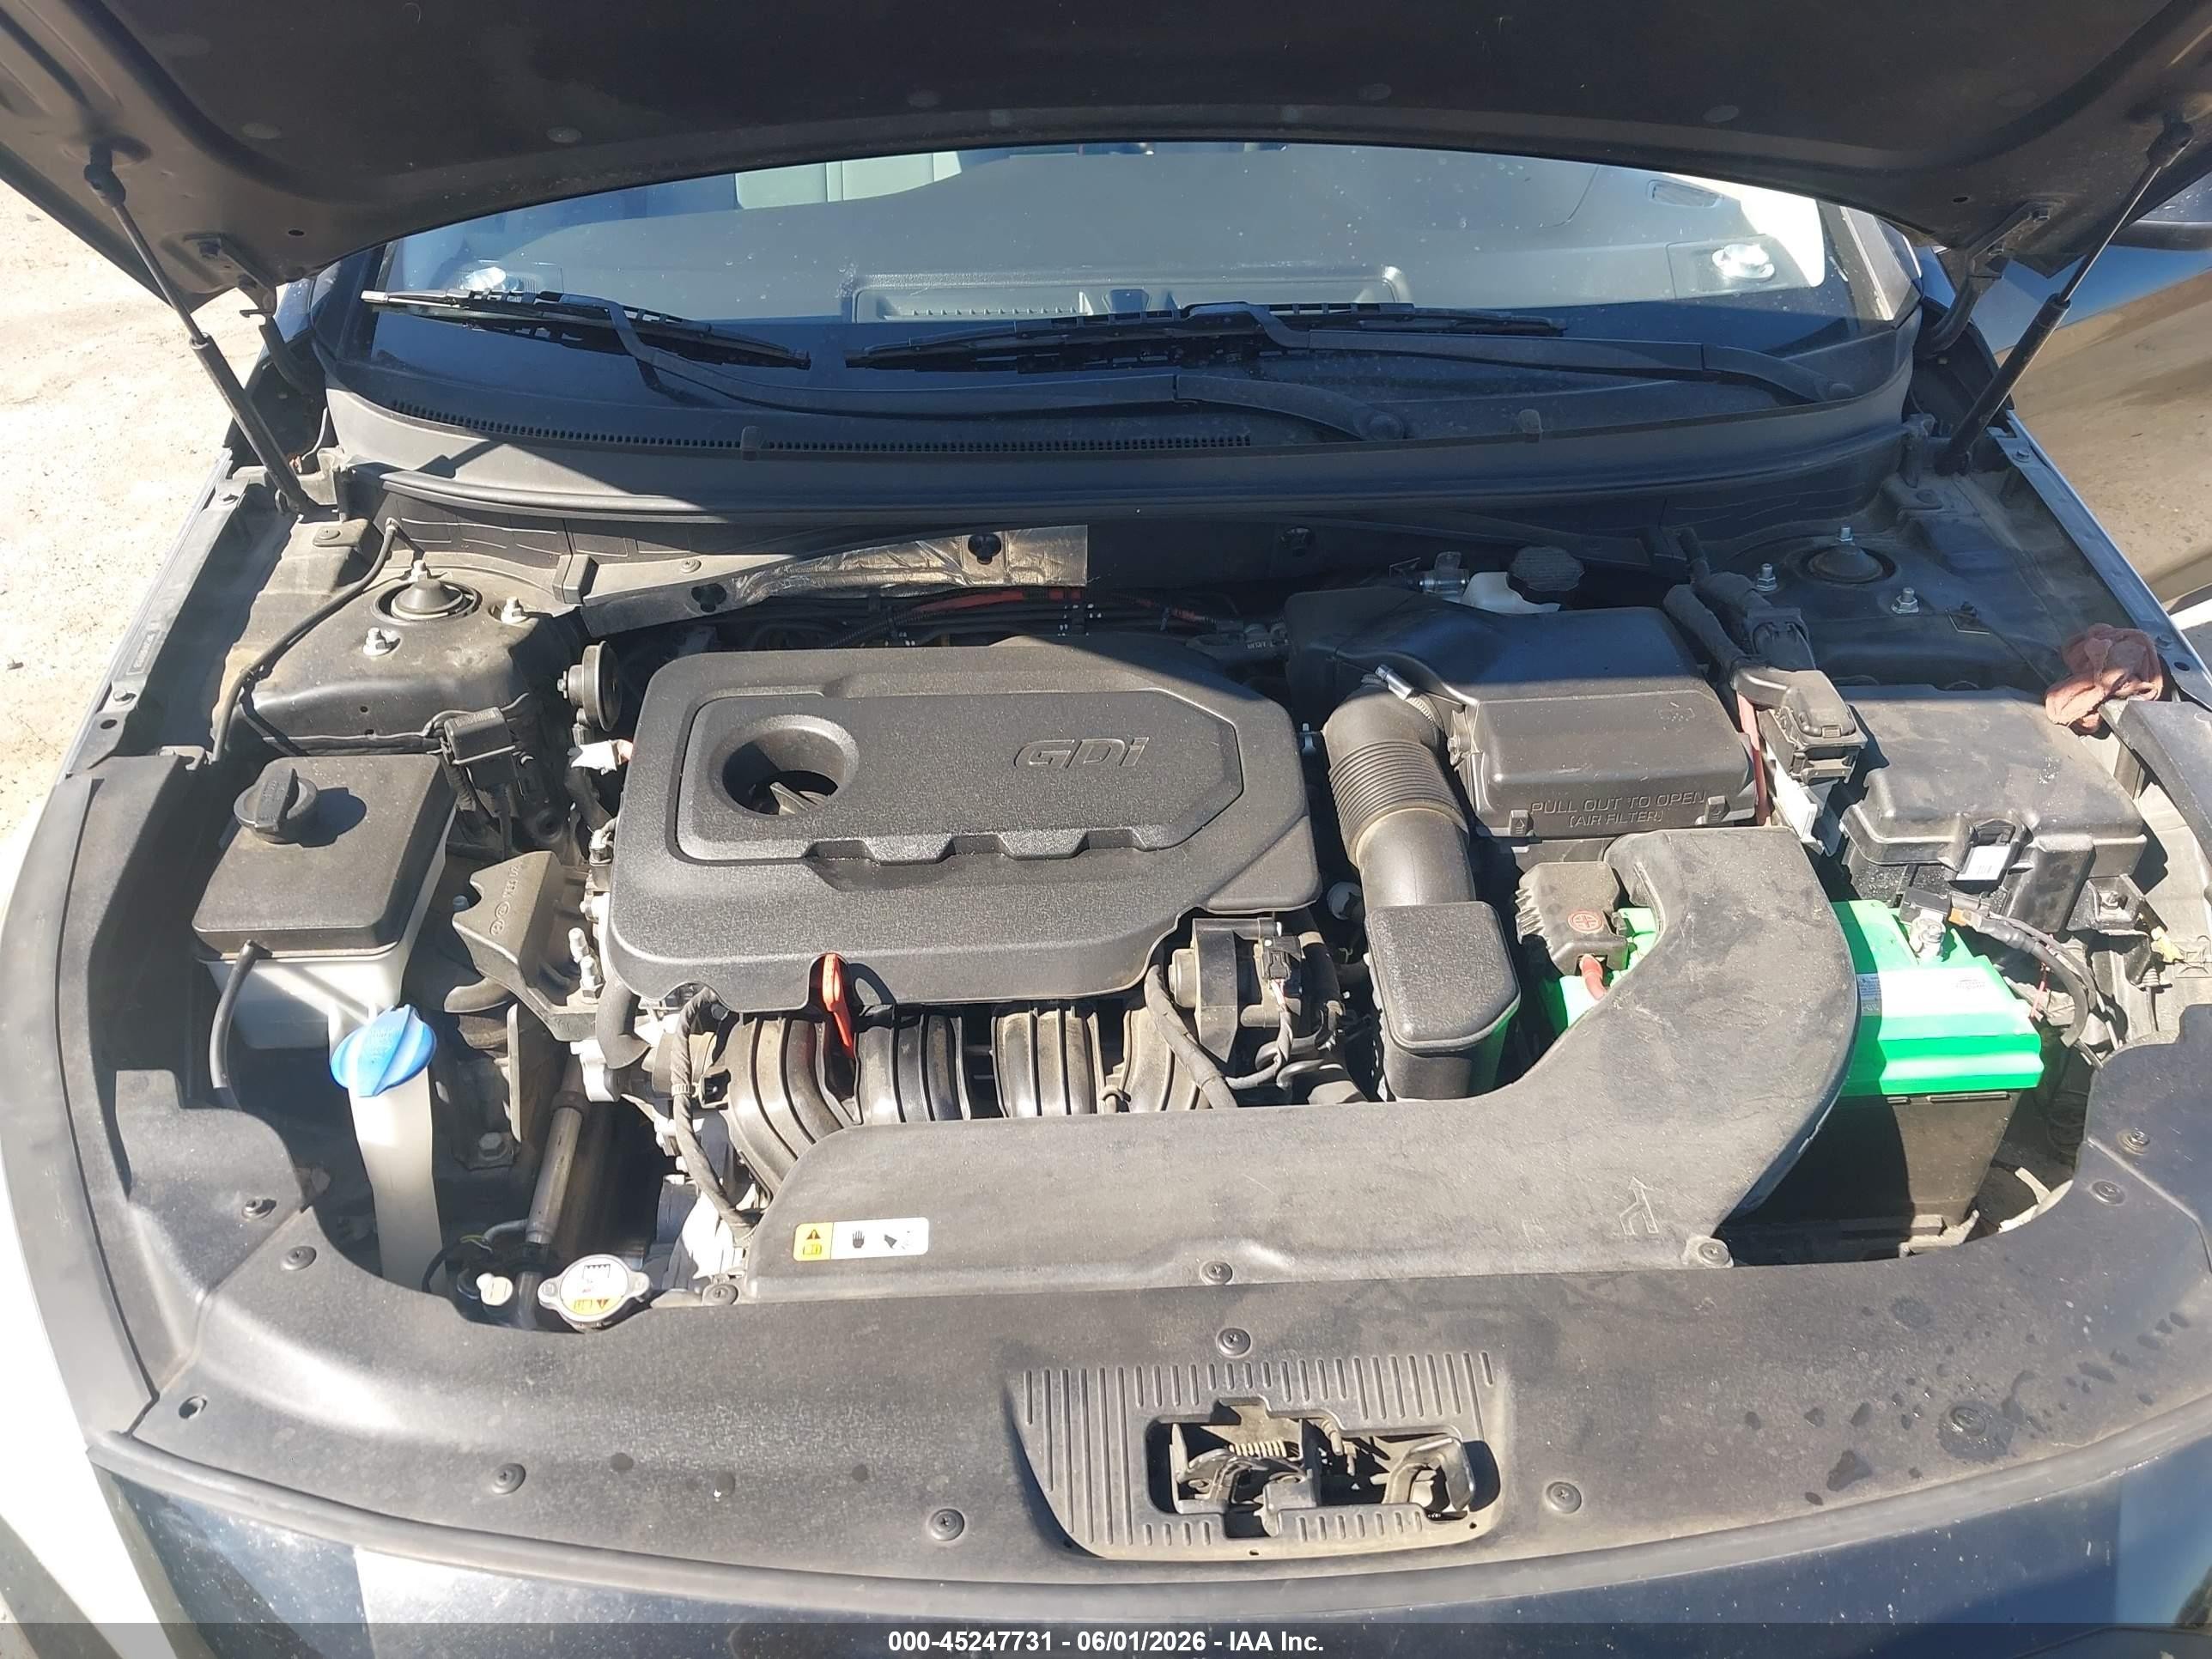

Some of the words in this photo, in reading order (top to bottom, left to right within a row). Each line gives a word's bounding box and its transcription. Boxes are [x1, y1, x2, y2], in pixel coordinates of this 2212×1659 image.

[1013, 736, 1150, 769] GDi
[1530, 799, 1577, 815] PULL
[1583, 797, 1622, 812] OUT
[1627, 795, 1650, 810] TO
[1655, 790, 1707, 808] OPEN
